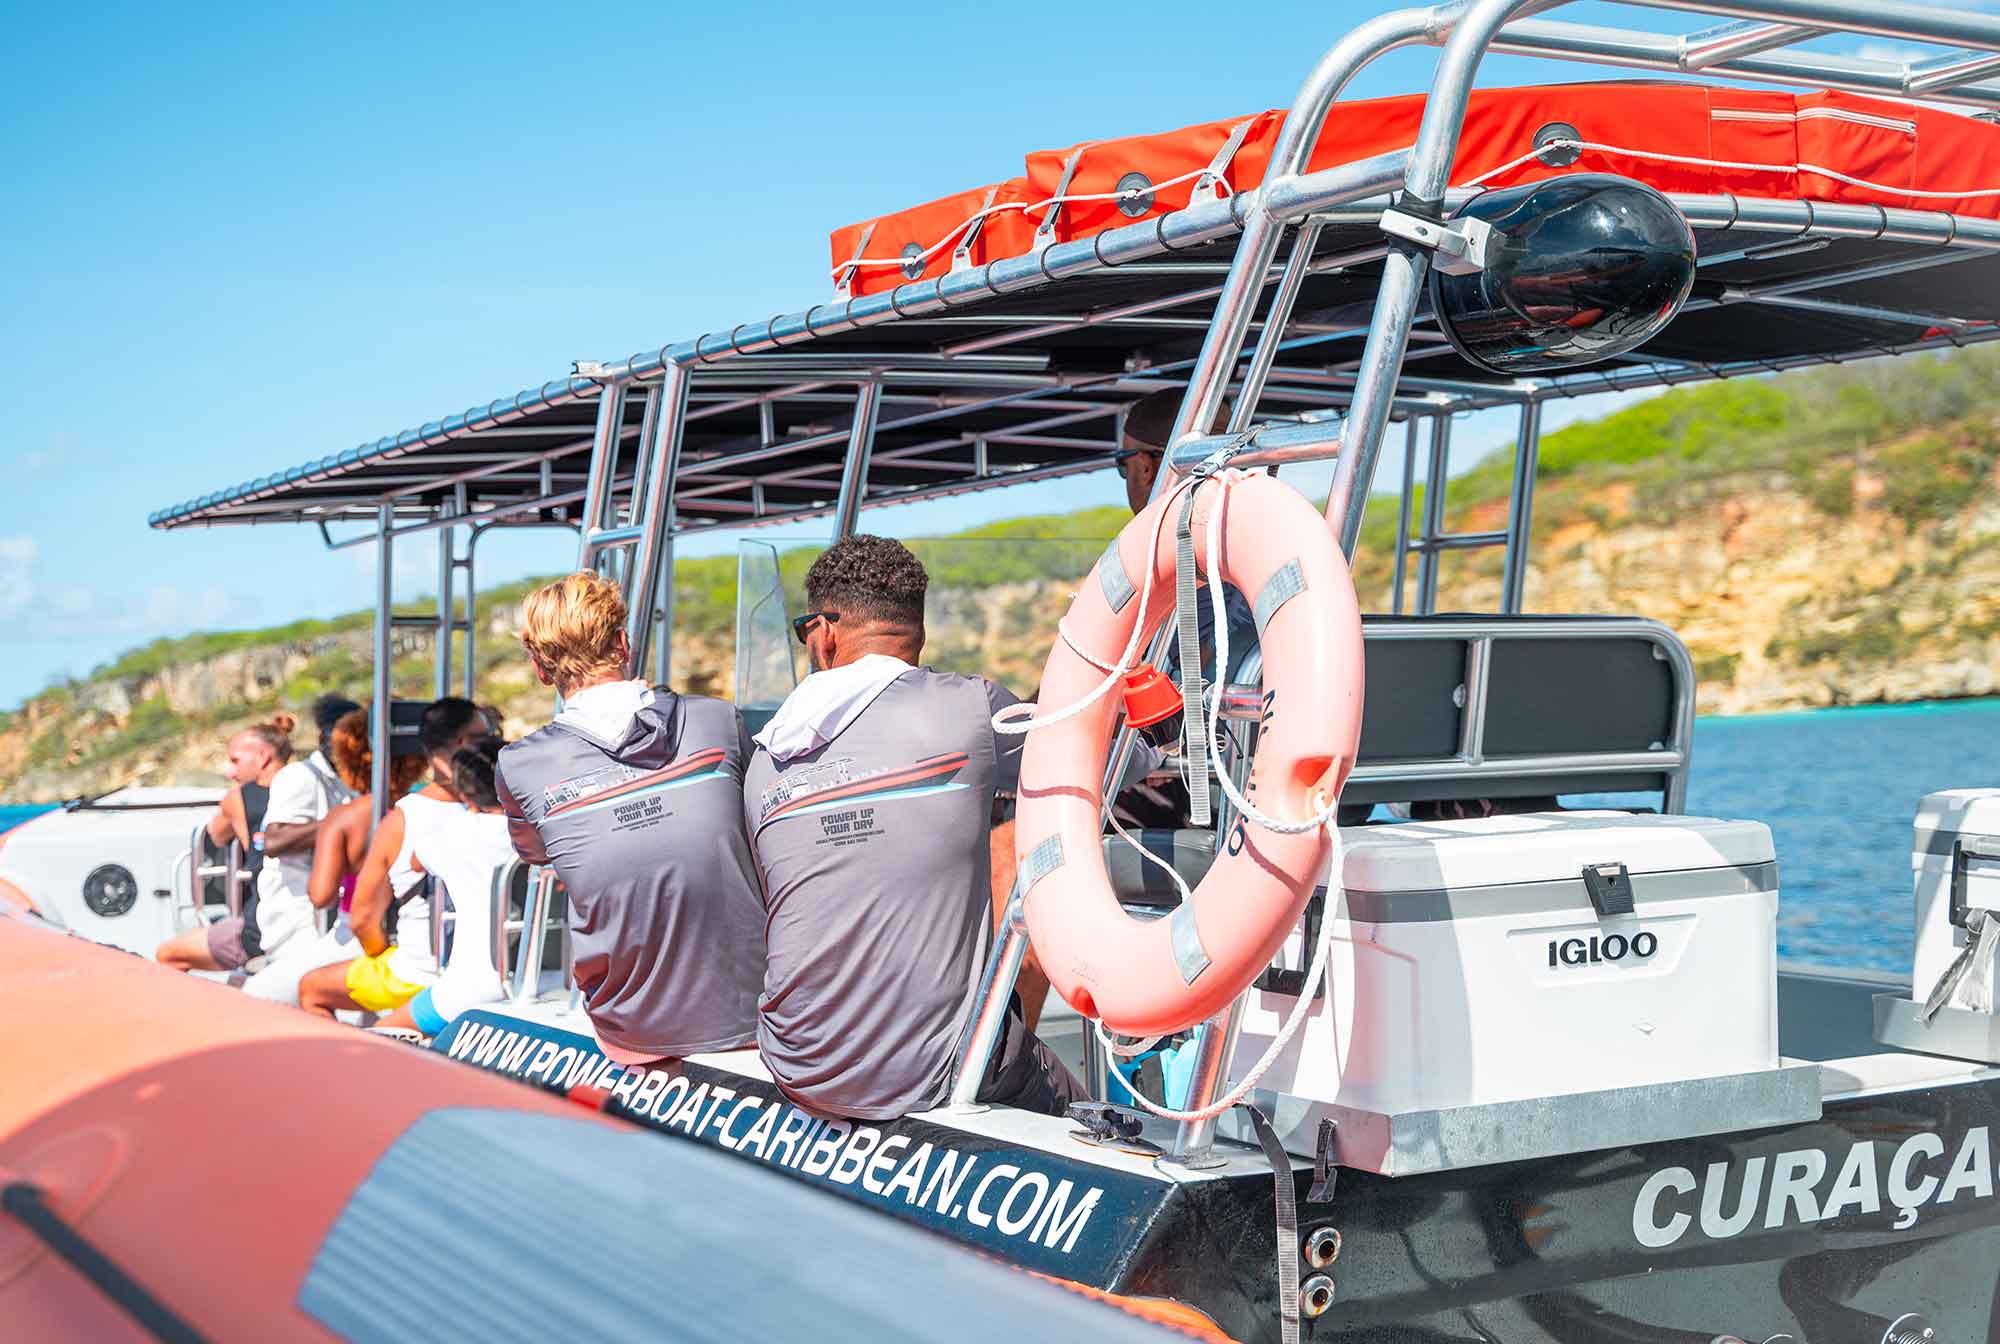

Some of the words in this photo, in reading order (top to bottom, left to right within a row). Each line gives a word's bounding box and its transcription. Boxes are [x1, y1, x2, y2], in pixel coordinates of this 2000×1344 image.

[613, 800, 647, 816] POWER
[648, 796, 662, 806] UP
[617, 810, 642, 823] YOUR
[644, 805, 663, 816] DAY
[820, 811, 857, 825] POWER
[860, 808, 875, 819] UP
[823, 822, 850, 836] YOUR
[853, 819, 874, 831] DAY
[1548, 931, 1658, 967] IGLOO
[447, 1020, 1104, 1254] WWW.POWERBOAT-CARIBBEAN.COM
[1632, 1126, 2000, 1248] CURAÇA
